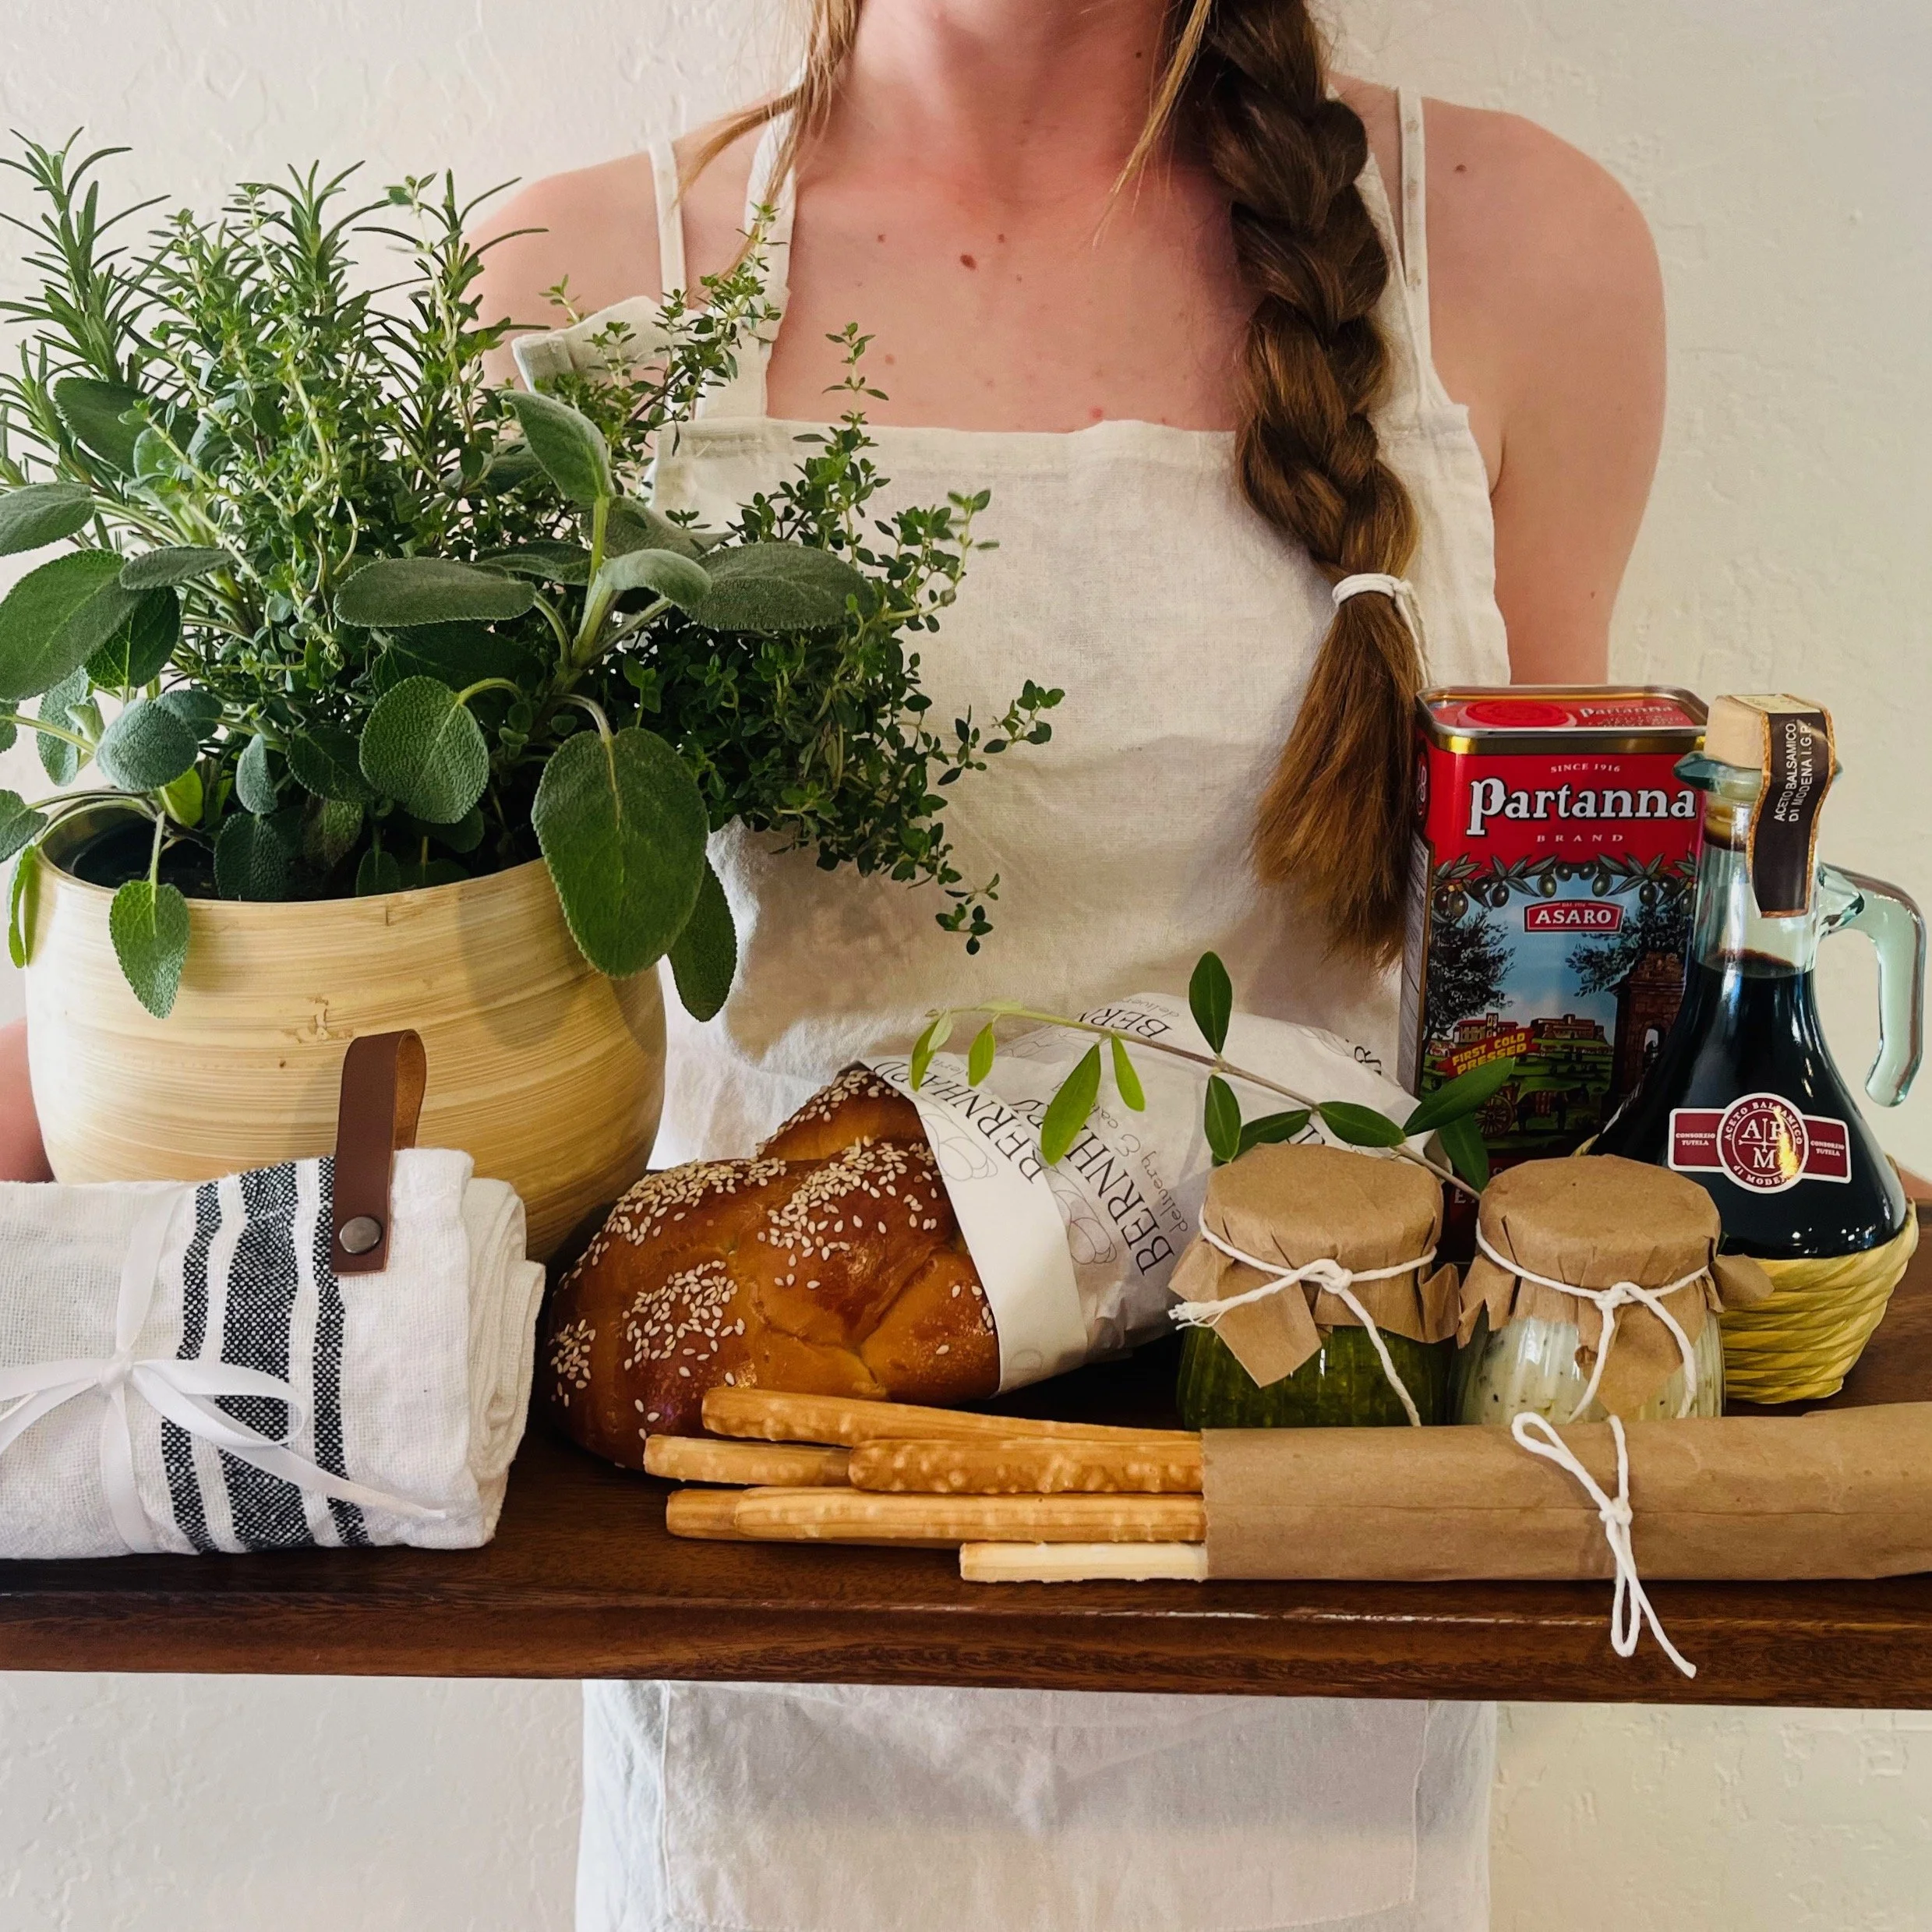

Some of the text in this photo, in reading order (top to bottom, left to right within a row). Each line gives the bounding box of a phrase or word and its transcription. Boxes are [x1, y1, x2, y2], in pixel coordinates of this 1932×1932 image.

[1550, 763, 1621, 773] SINCE 1916
[1774, 723, 1797, 821] ACETO BALSAMICO
[1789, 722, 1812, 822] DI MODENA I.G.P.
[1466, 778, 1696, 835] Partanna
[1537, 834, 1623, 842] BRAND
[1535, 909, 1612, 924] ASARO
[1452, 1033, 1525, 1066] FIRST COLD
[1457, 1043, 1528, 1075] PRESSED
[1724, 1107, 1748, 1140] ACETO
[1810, 1140, 1845, 1150] CONSORZIO
[1816, 1148, 1841, 1157] TUTELA
[1141, 1150, 1189, 1232] delivery
